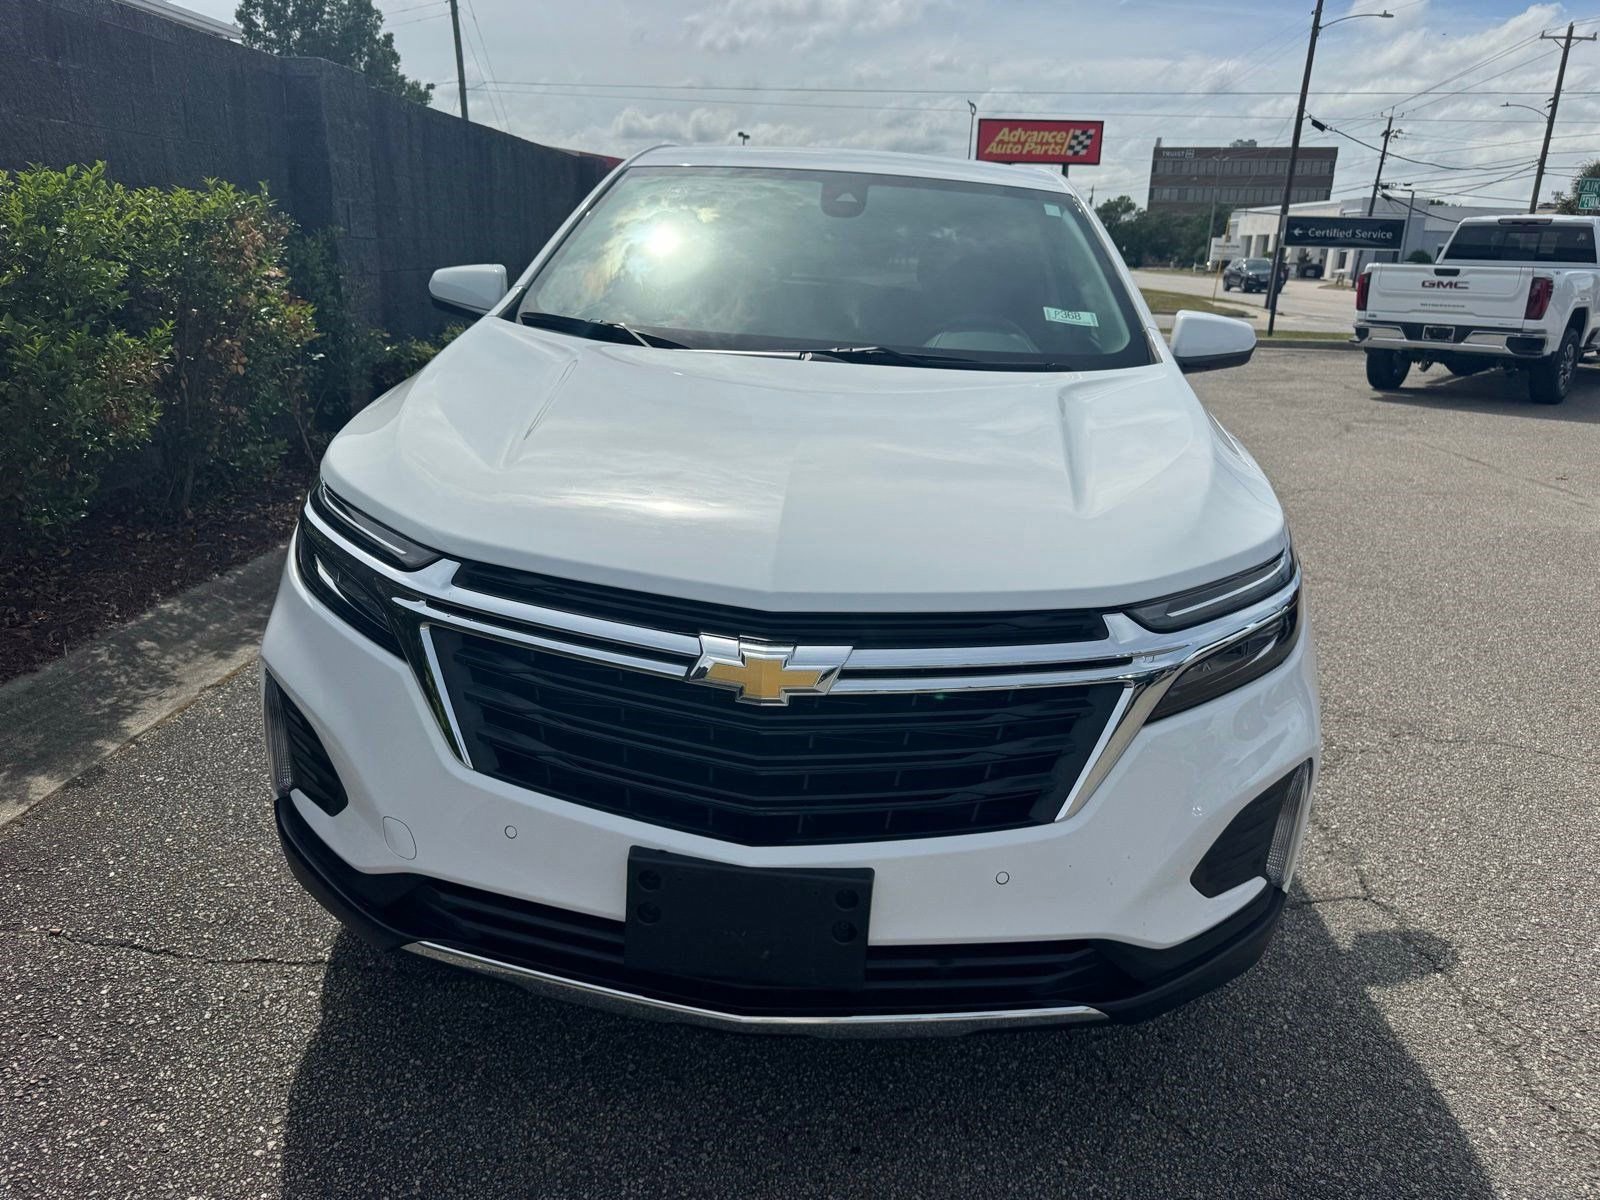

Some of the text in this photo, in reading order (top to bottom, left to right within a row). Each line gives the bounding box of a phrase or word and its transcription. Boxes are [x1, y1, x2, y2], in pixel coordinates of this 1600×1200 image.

[995, 127, 1066, 143] Advance
[984, 142, 1062, 155] Auto Parts
[1308, 227, 1393, 239] Certified Service
[1421, 280, 1470, 289] GMC
